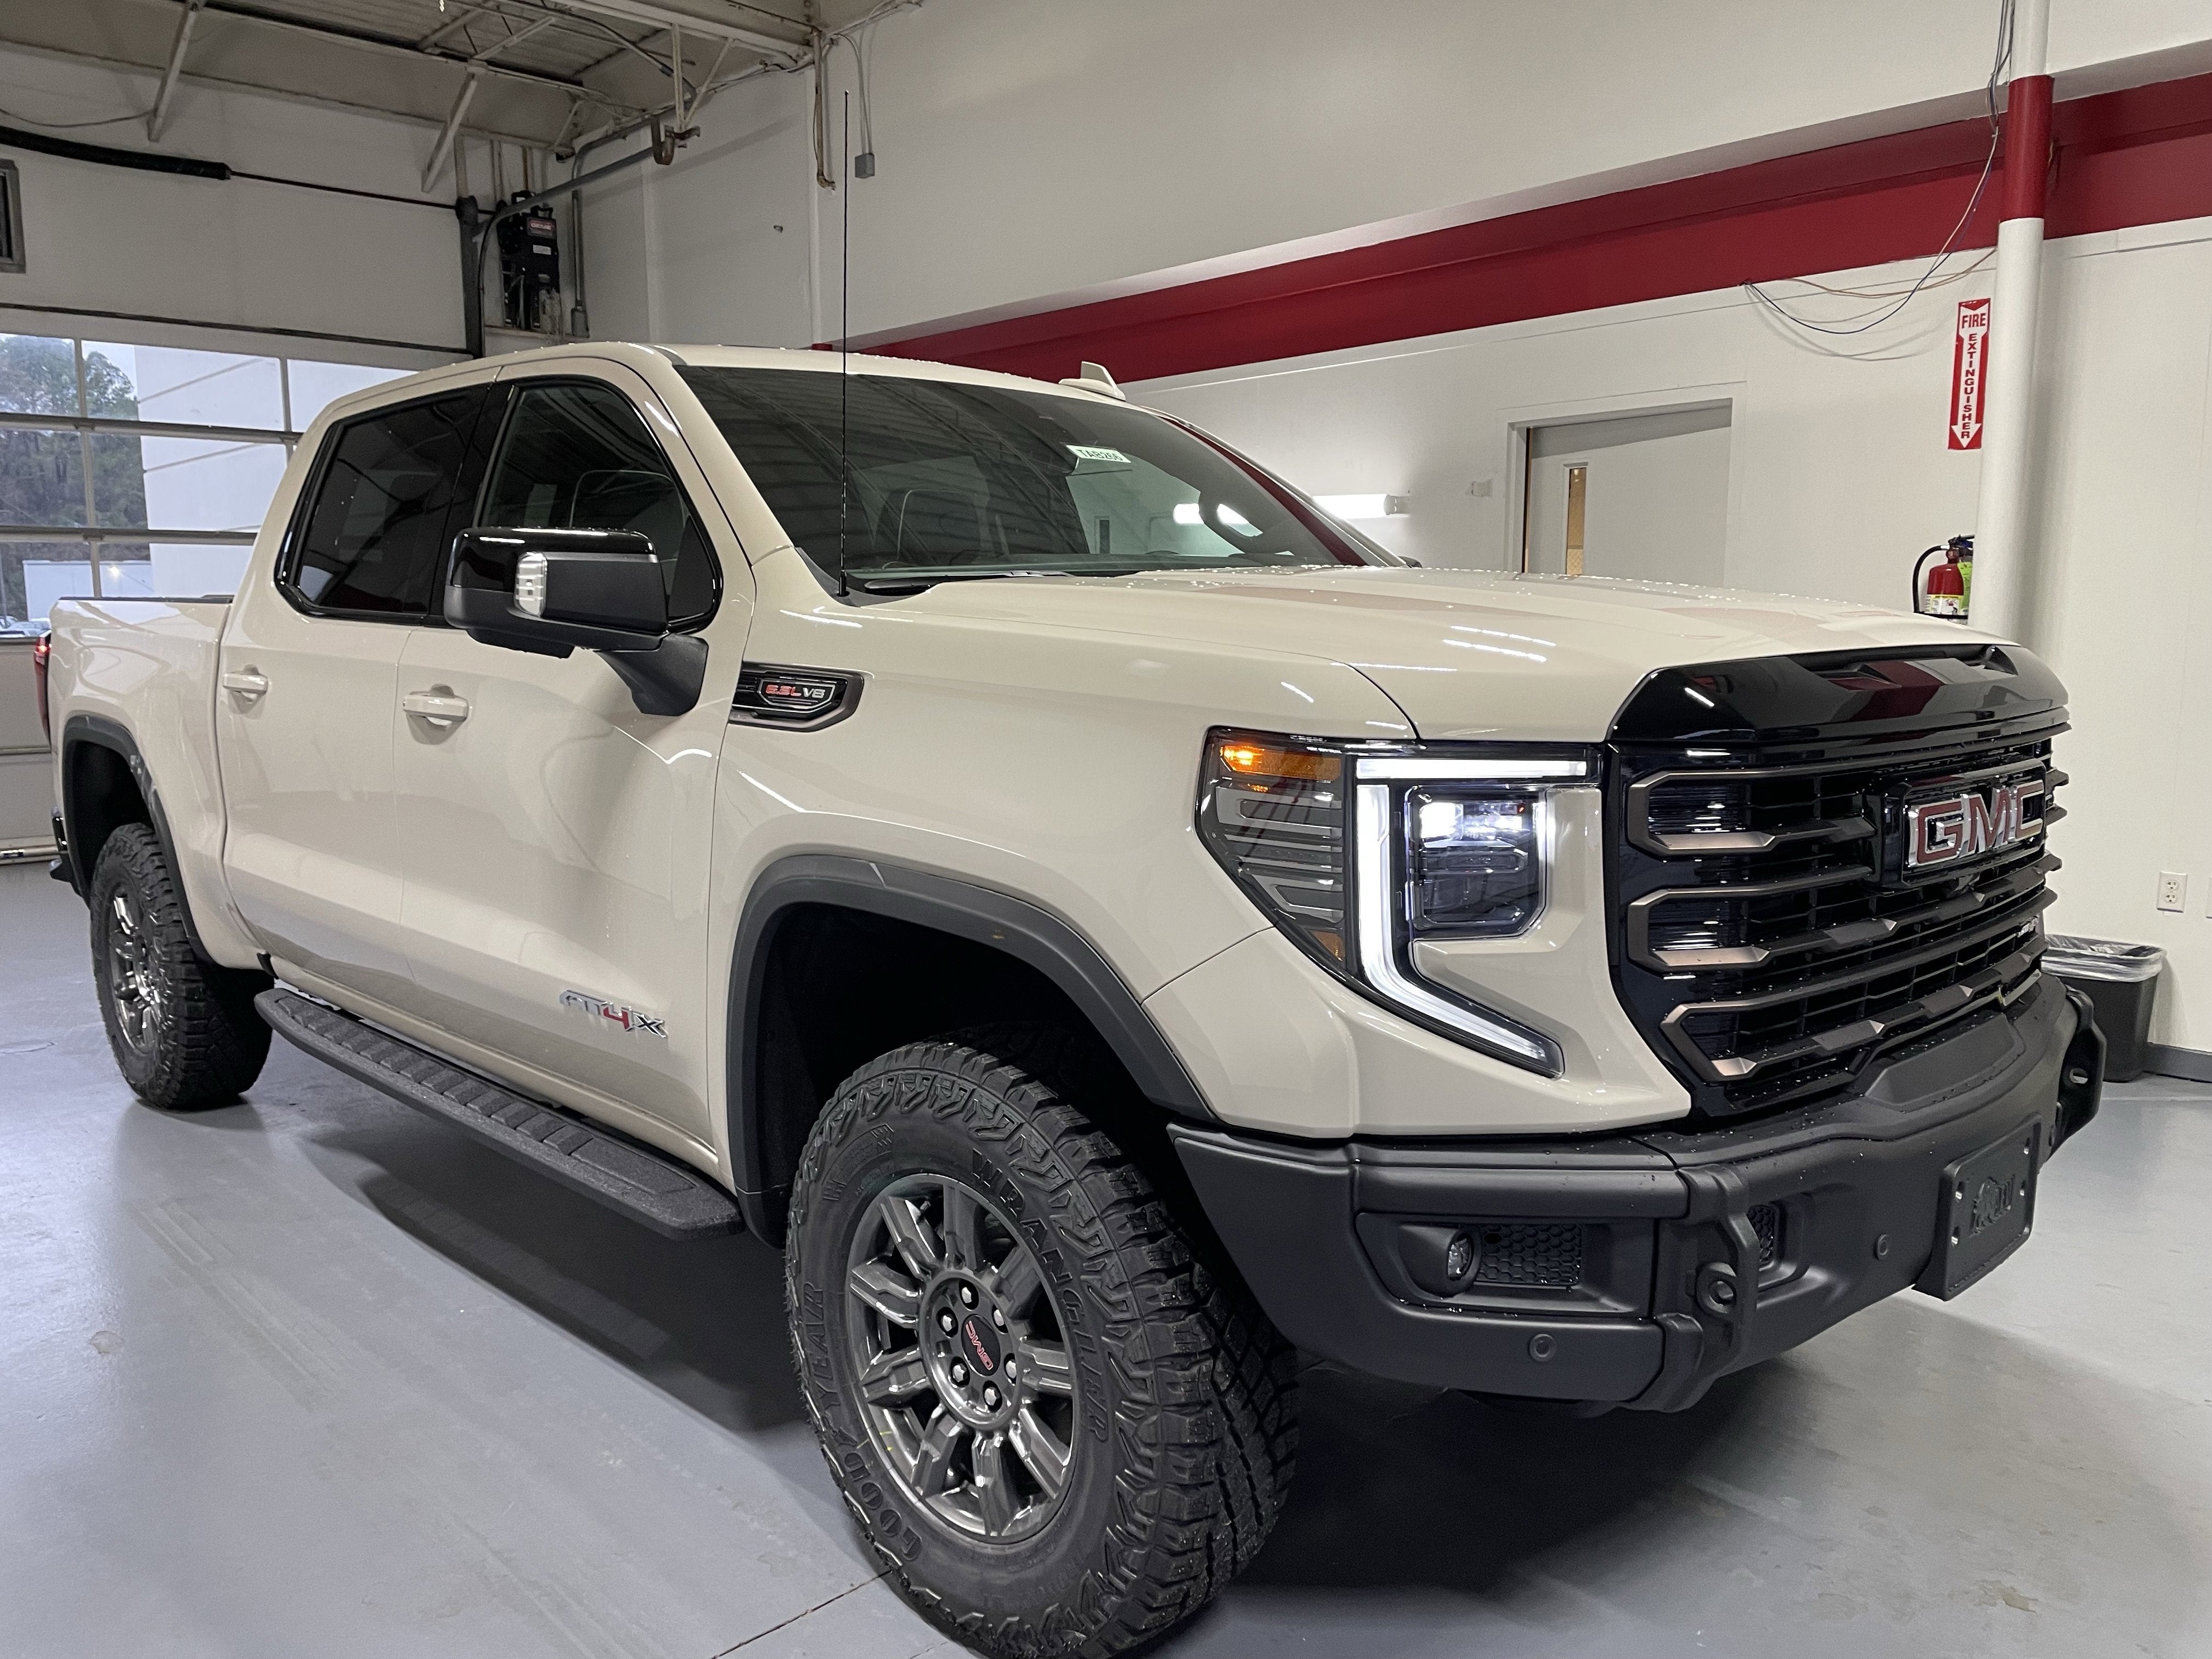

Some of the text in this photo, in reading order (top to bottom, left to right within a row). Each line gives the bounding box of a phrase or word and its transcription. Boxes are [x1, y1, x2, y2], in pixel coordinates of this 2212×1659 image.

[1961, 313, 1986, 329] FIRE
[1961, 333, 1977, 439] EXTINGUISHER
[803, 687, 826, 698] V8
[1908, 780, 2045, 868] GMC
[559, 990, 666, 1037] AT4X
[972, 1148, 1109, 1441] WRANGLER
[966, 1320, 994, 1370] GMC
